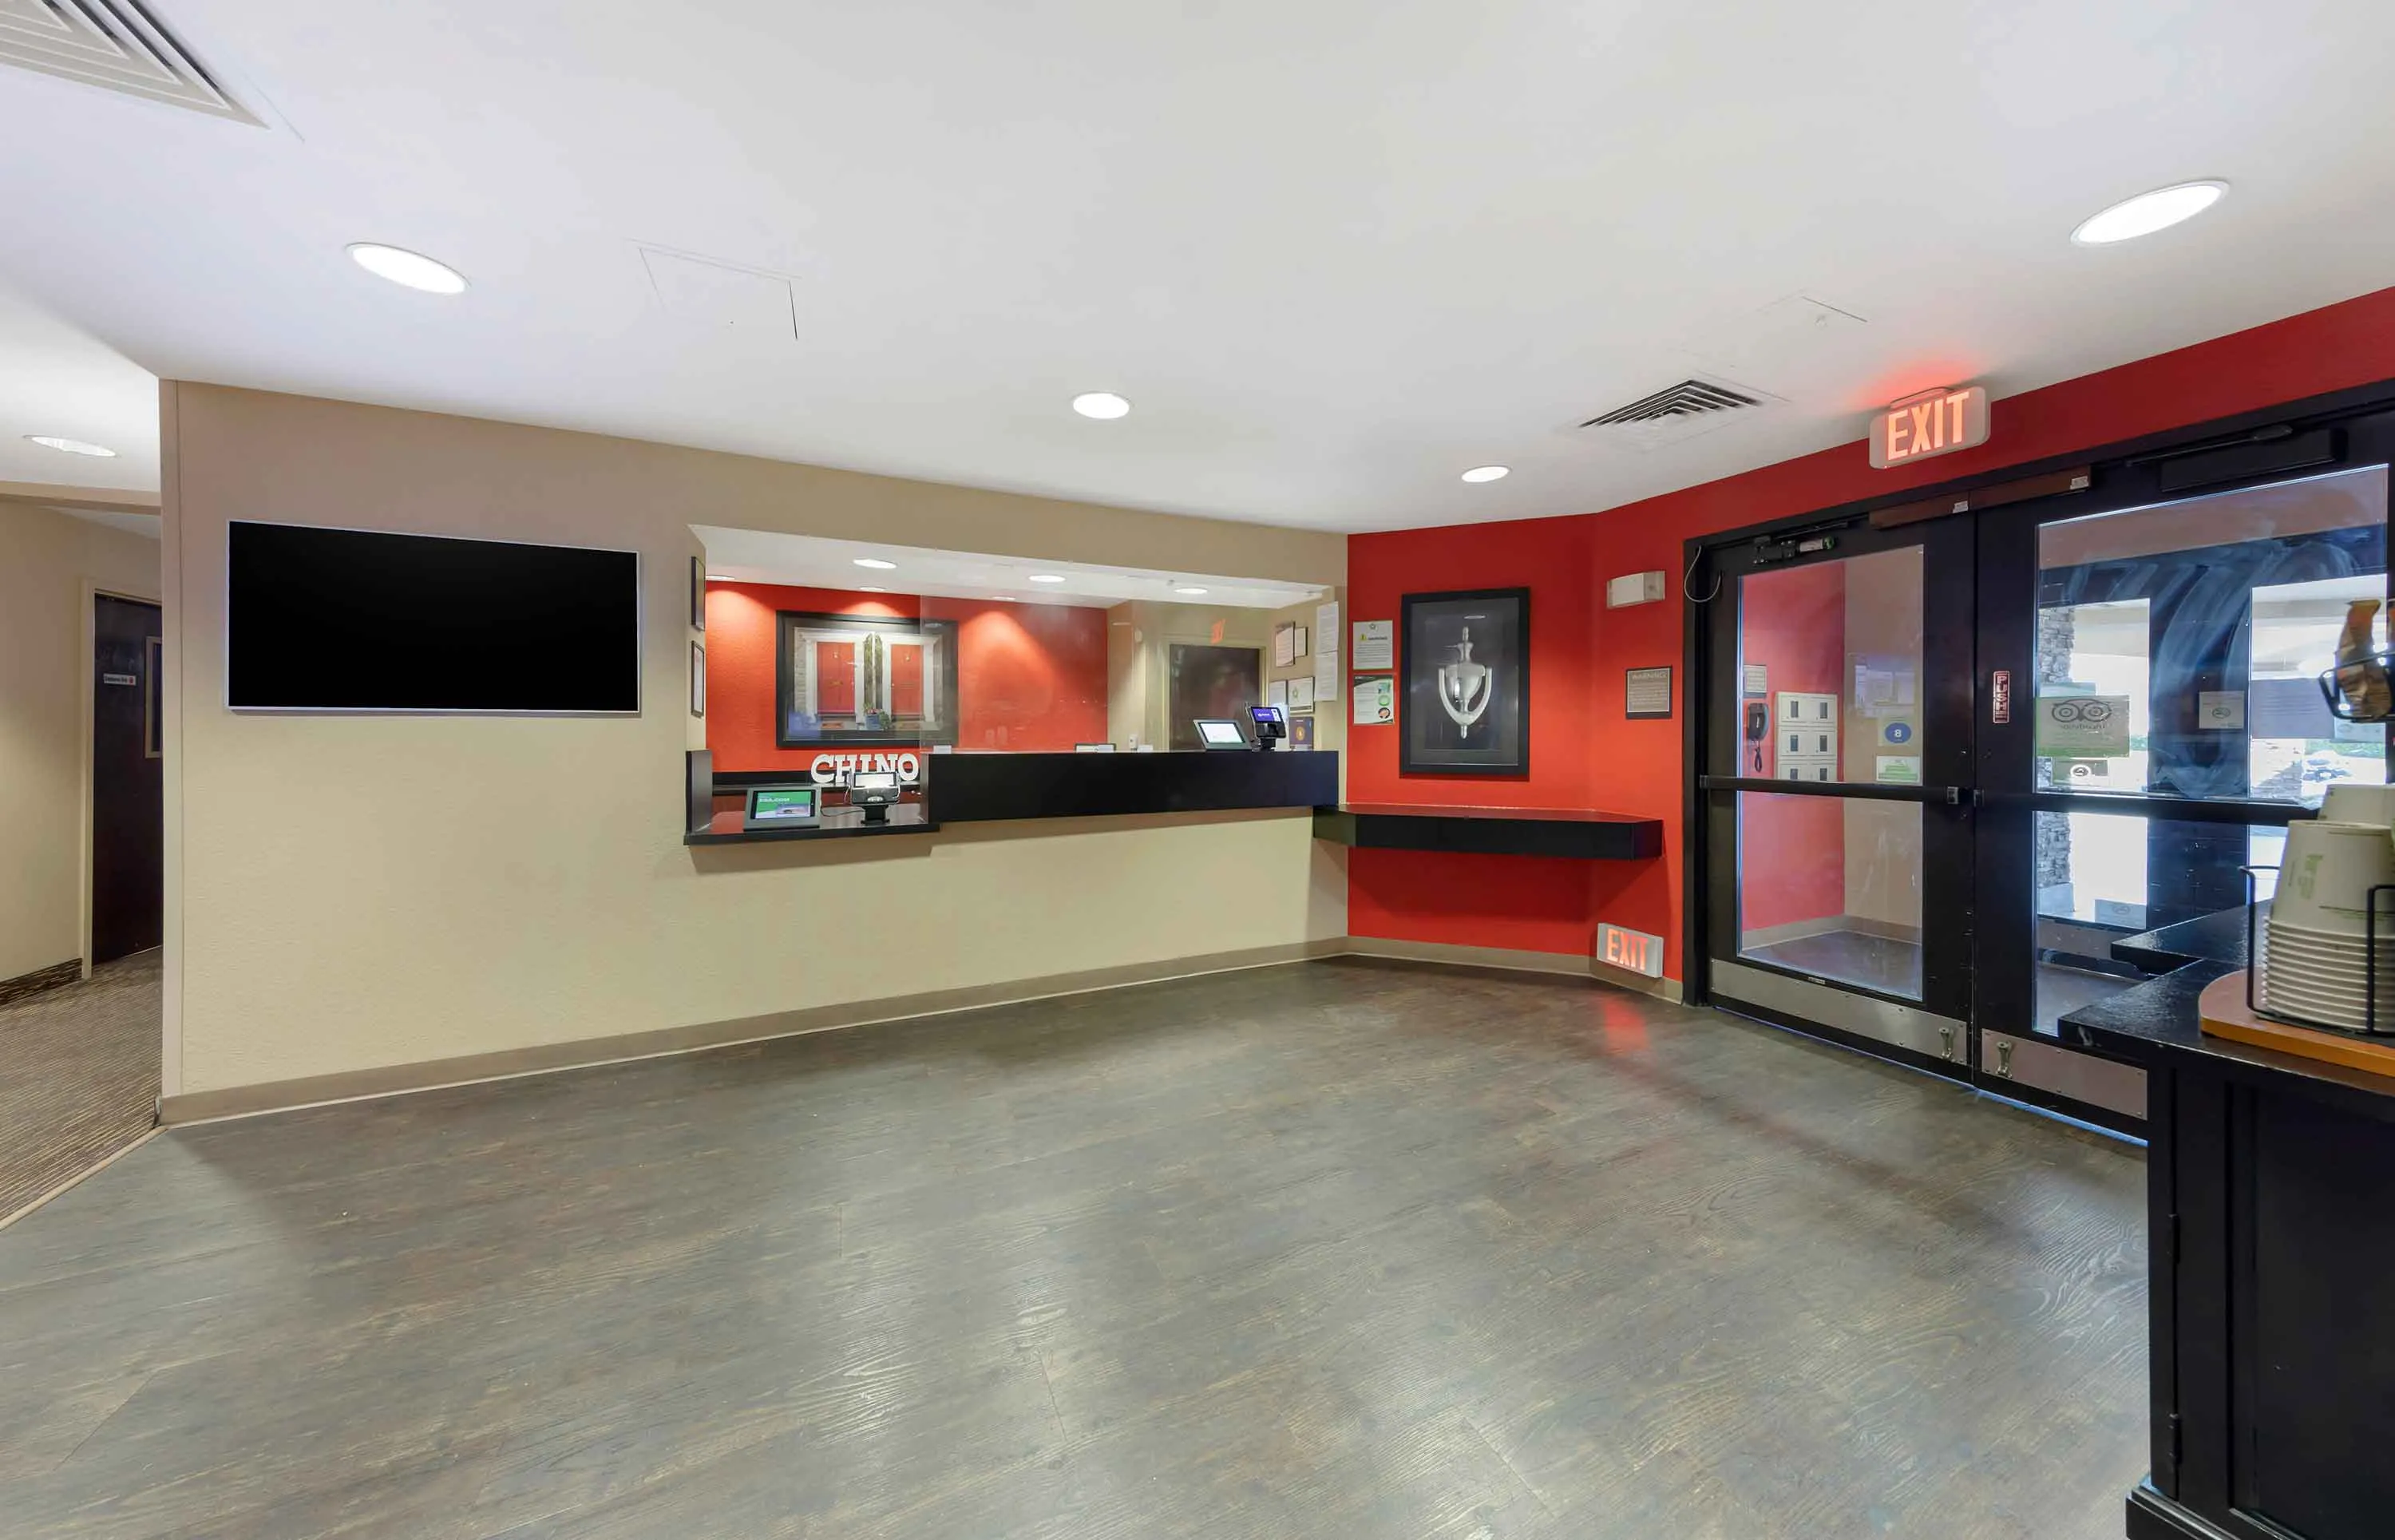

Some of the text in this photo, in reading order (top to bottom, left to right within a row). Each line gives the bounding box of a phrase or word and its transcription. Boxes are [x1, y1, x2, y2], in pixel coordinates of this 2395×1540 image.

[1887, 391, 1970, 461] EXIT
[1996, 675, 2008, 711] PUSH
[810, 753, 920, 784] CHINO
[1607, 928, 1649, 971] EXIT
